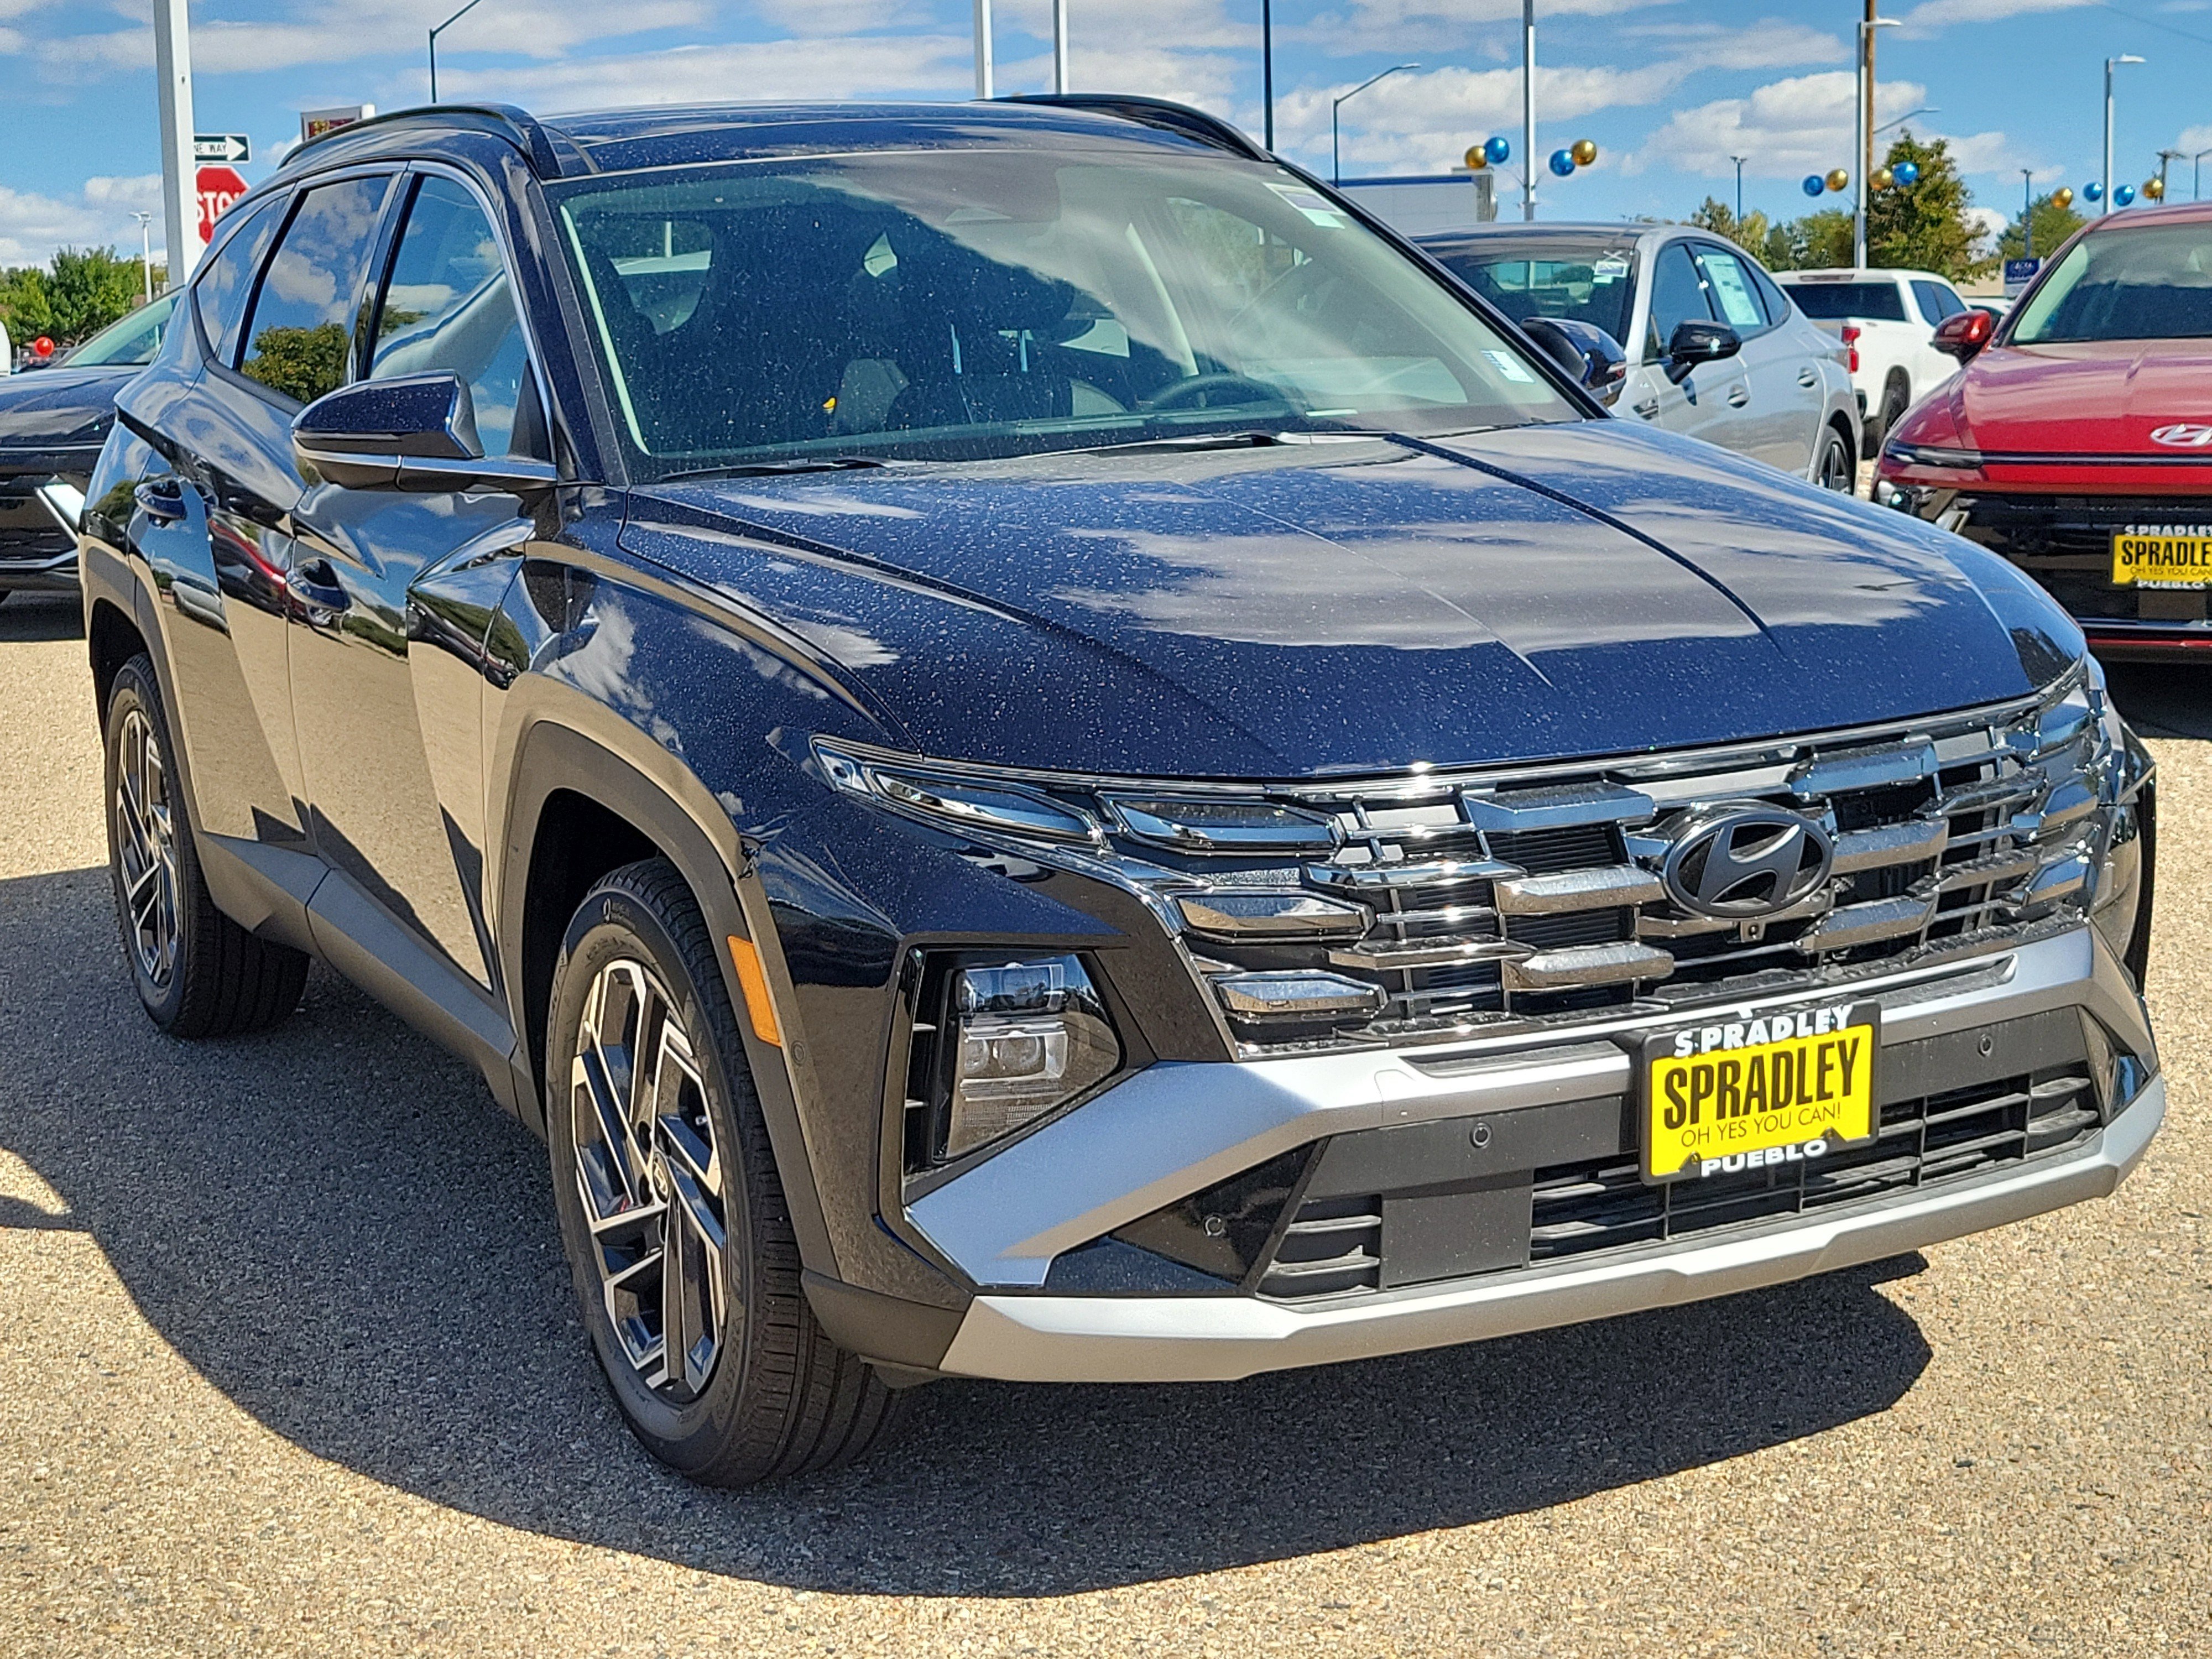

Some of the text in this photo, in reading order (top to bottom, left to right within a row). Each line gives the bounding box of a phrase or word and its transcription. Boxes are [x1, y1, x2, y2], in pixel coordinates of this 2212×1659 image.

[194, 143, 227, 154] NE WAY
[197, 191, 240, 223] STO
[2121, 540, 2212, 566] SPRADLE
[2130, 566, 2212, 576] OH YES YOU CAN
[2137, 580, 2205, 590] PUEBLO
[1674, 1004, 1853, 1057] SPRADLEY
[1663, 1037, 1860, 1130] SPRADLEY
[1681, 1103, 1841, 1148] OH YES YOU CAN!
[1701, 1139, 1828, 1177] PUEBLO
